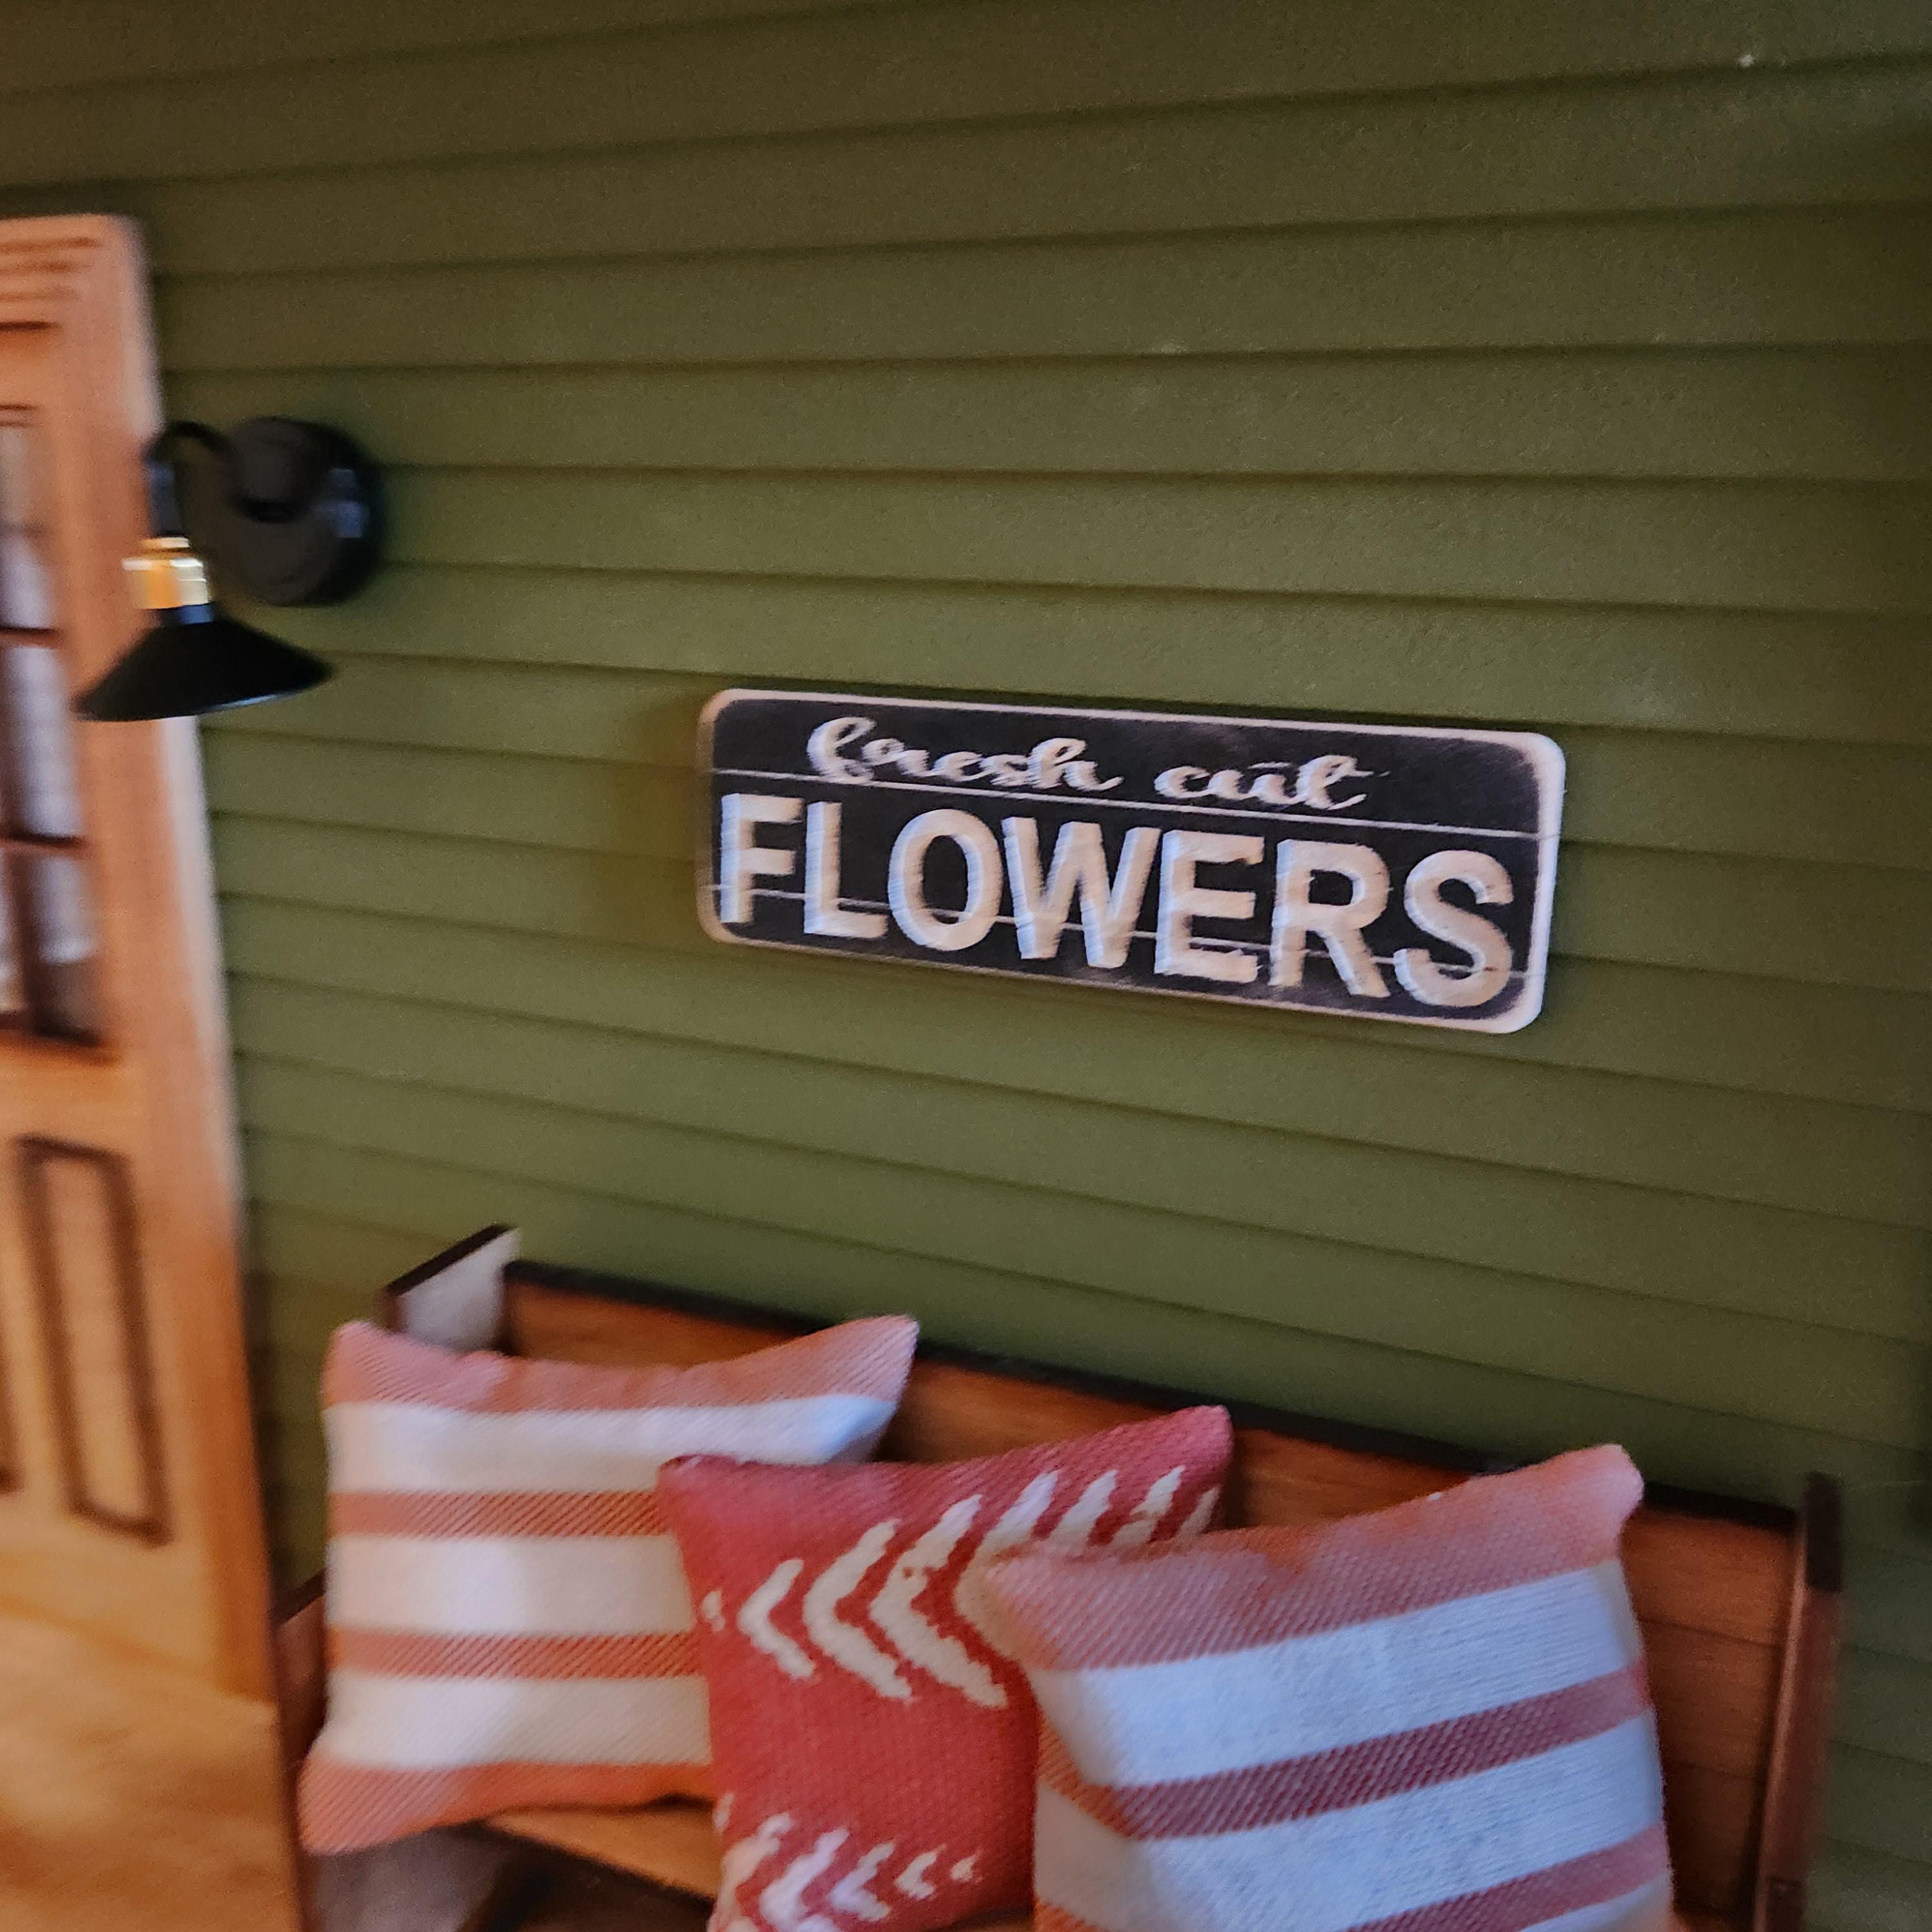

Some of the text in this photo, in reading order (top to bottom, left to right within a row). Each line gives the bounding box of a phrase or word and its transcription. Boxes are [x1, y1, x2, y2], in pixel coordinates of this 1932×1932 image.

[806, 716, 1388, 810] fresh cut
[719, 792, 1514, 1008] FLOWERS
